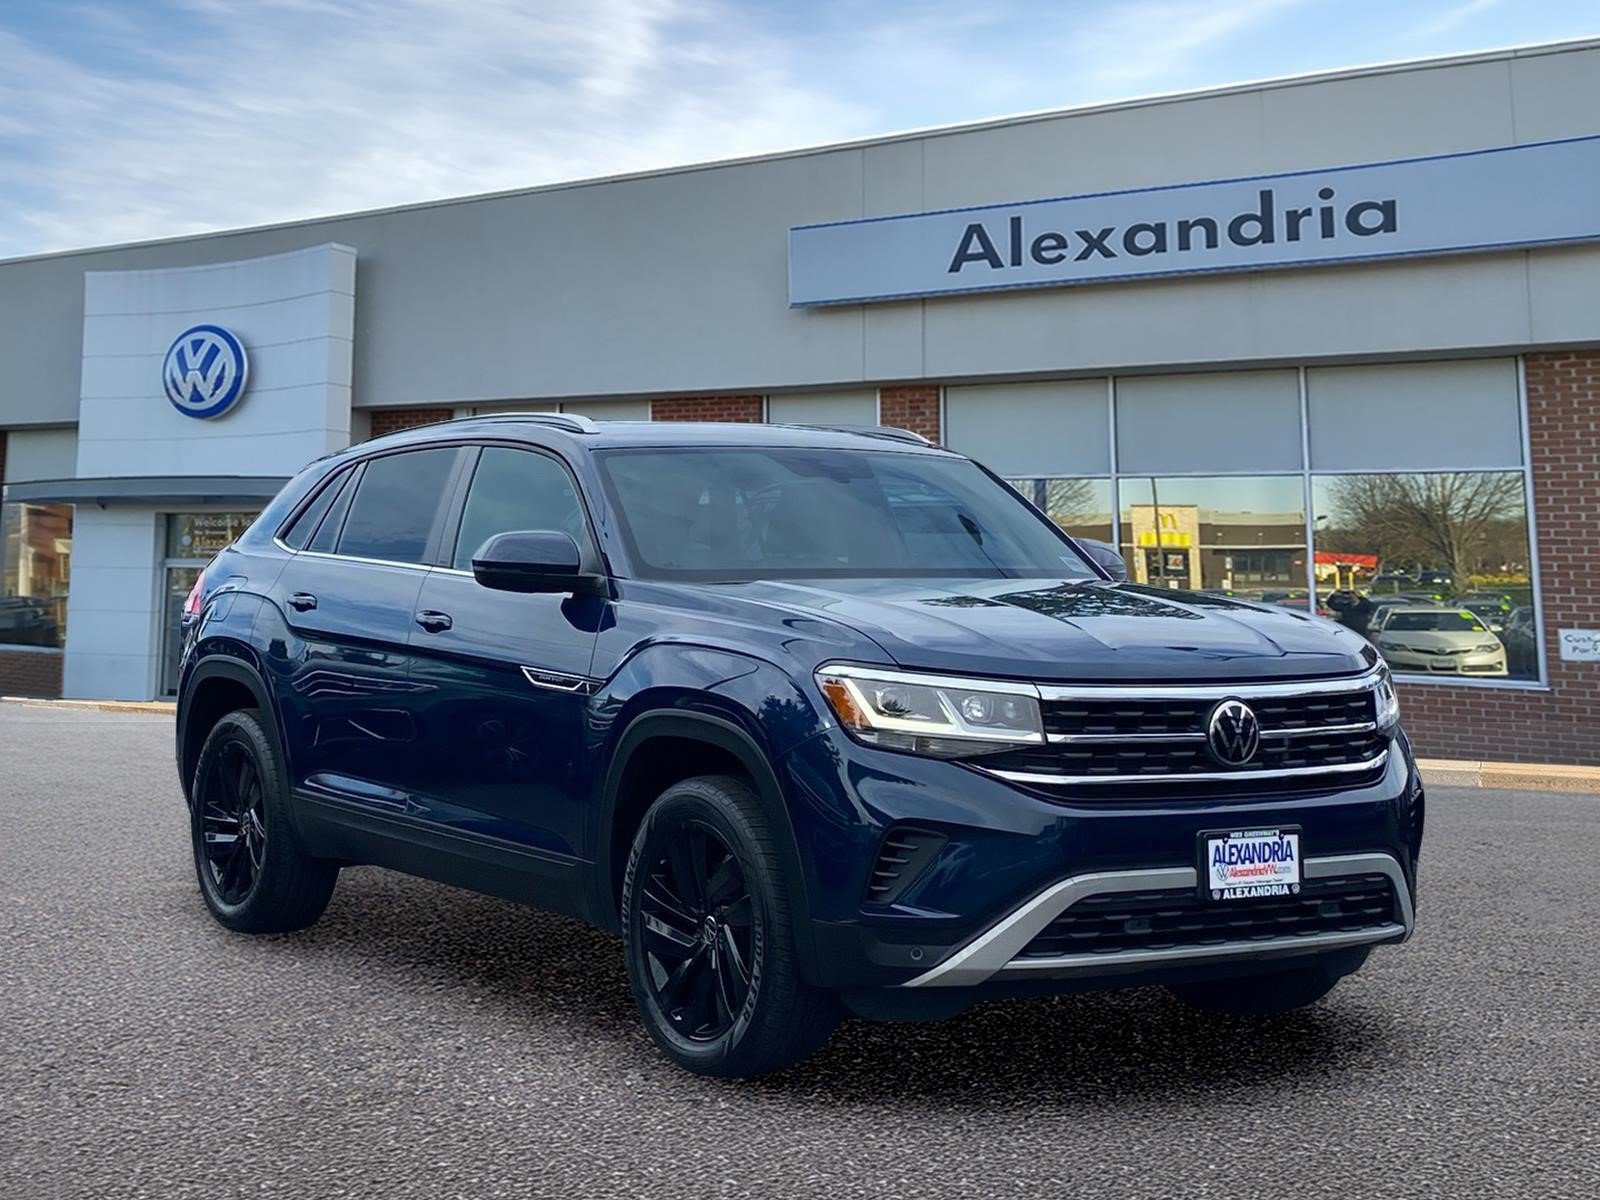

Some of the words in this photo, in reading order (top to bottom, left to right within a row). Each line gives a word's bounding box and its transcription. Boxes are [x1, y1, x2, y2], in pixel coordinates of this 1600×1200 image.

[947, 187, 1398, 273] Alexandria
[165, 329, 240, 413] VW
[1210, 701, 1258, 765] VW
[1213, 839, 1294, 867] ALEXANDRIA
[1223, 884, 1290, 899] ALEXANDRIA
